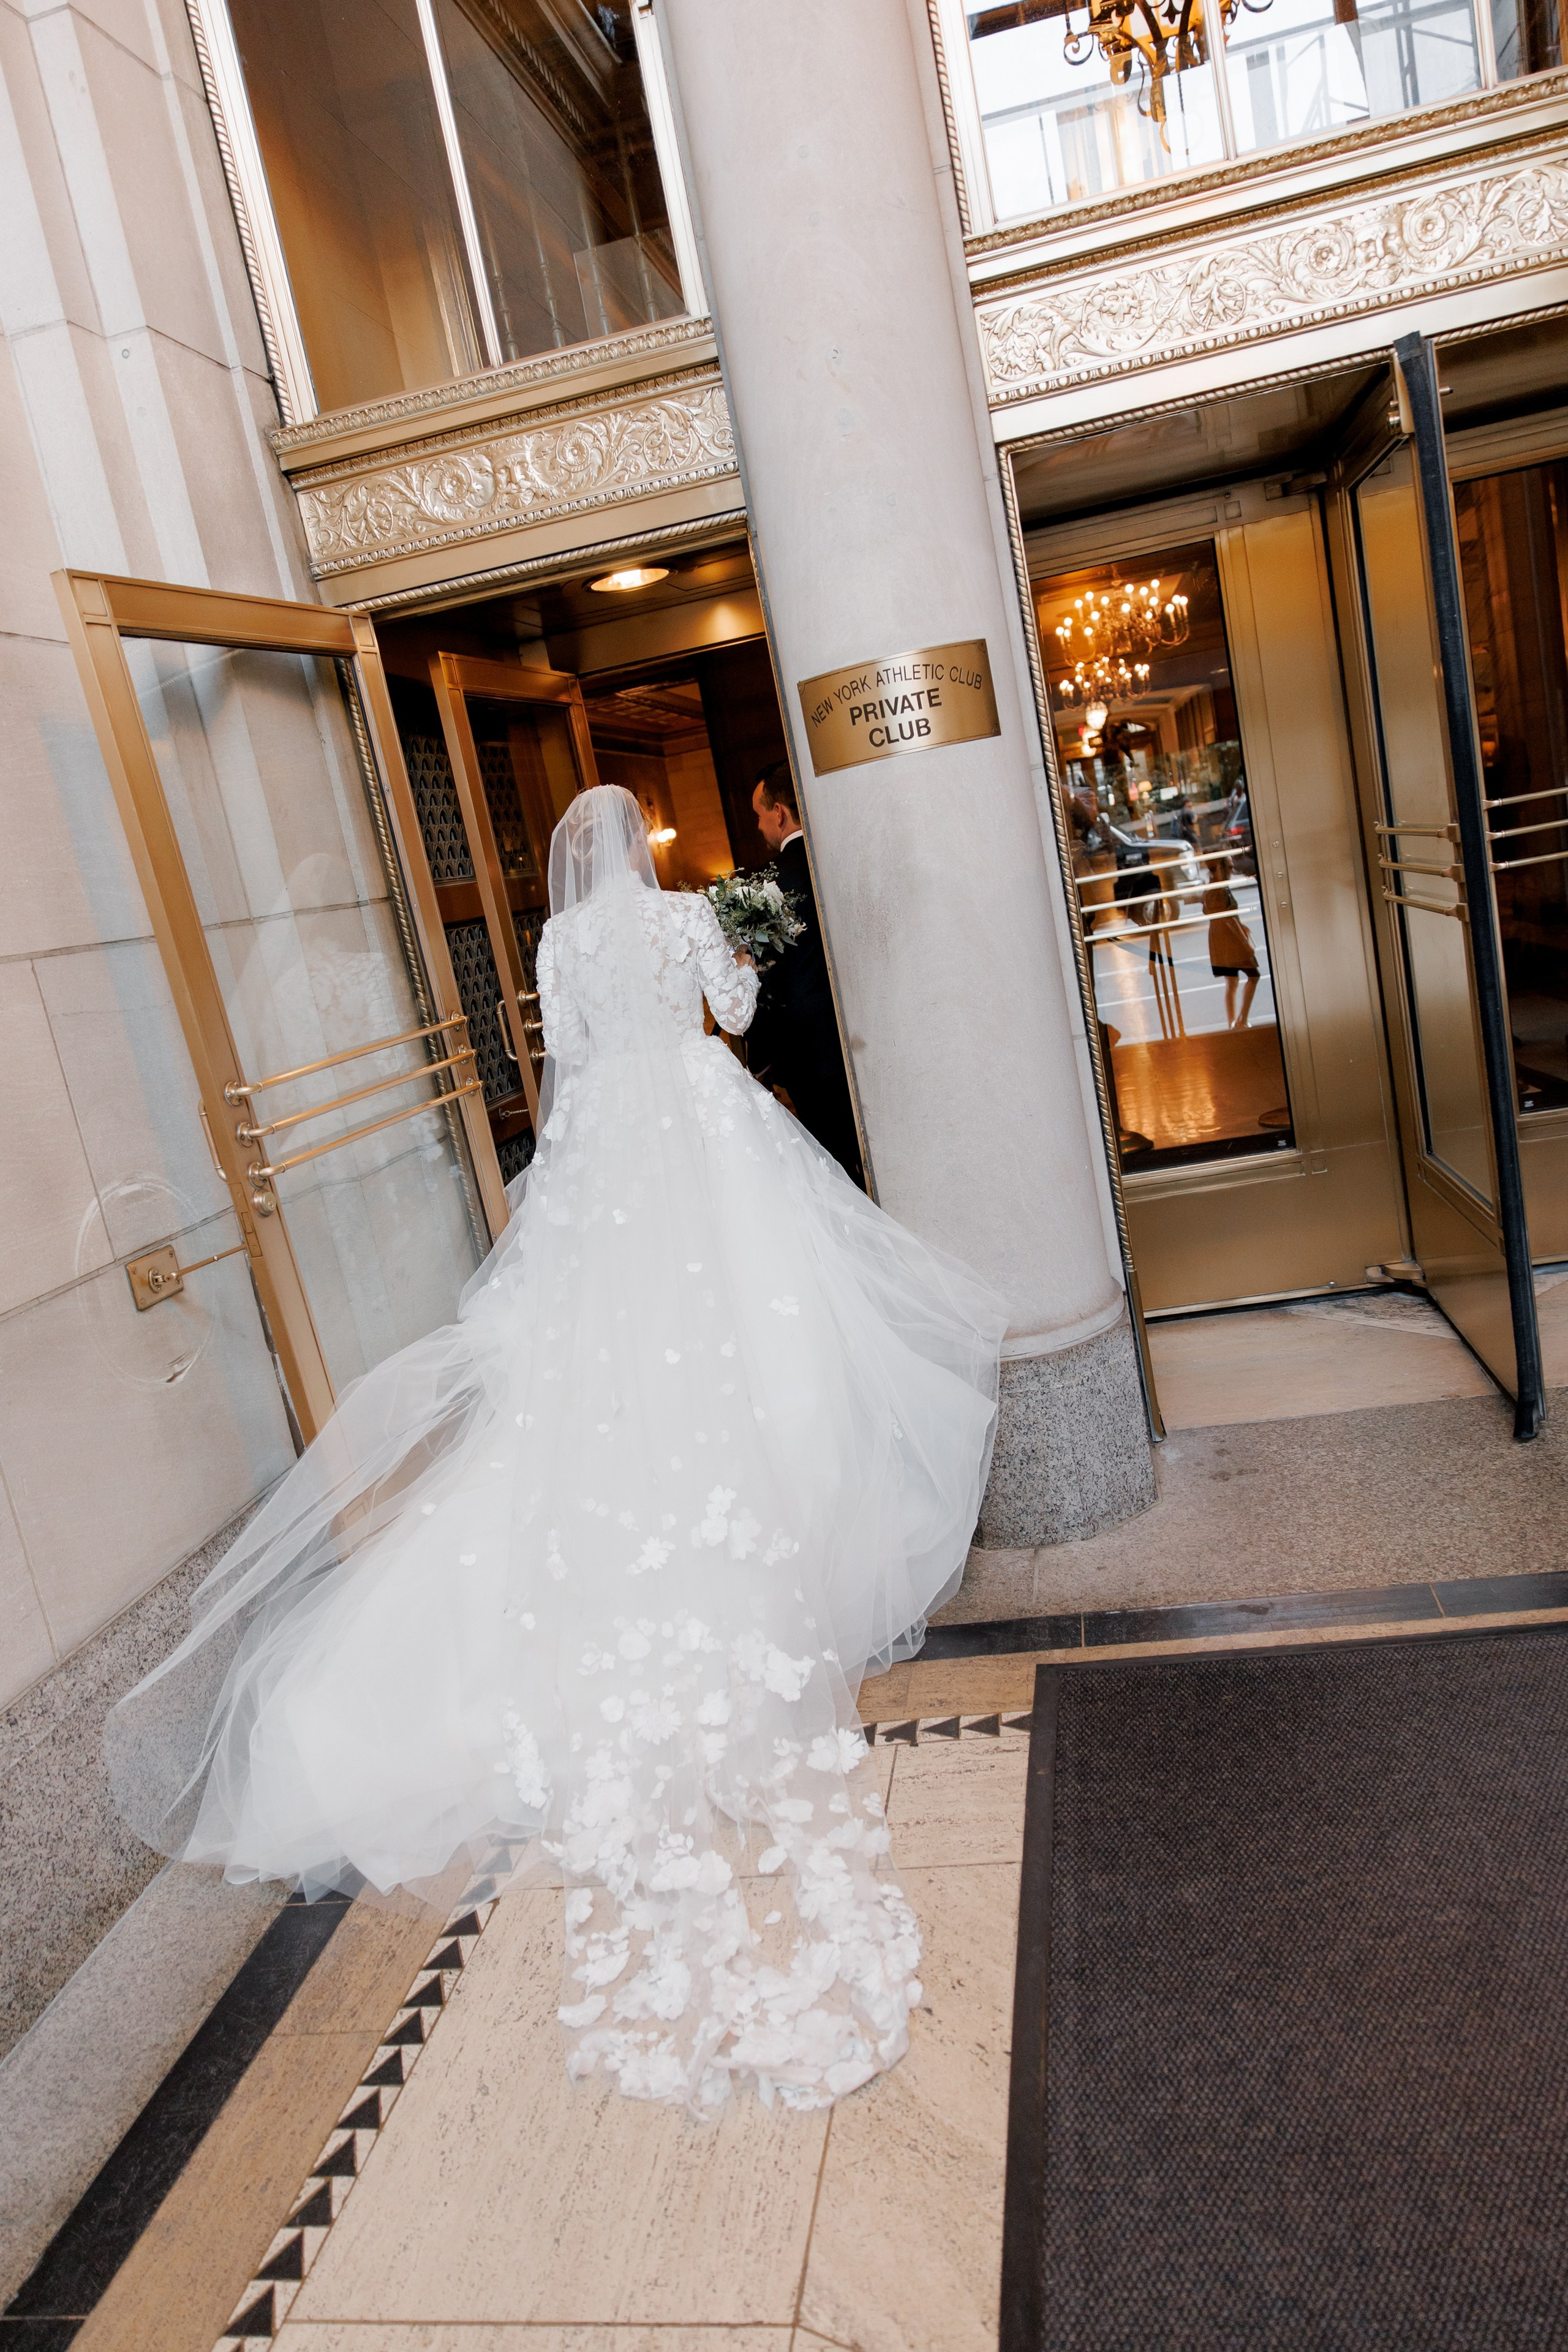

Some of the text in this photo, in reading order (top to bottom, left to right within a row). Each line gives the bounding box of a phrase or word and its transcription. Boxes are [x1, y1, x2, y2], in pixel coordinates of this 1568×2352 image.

[810, 664, 982, 728] NEW YORK ATHLETIC CLUB
[849, 687, 942, 726] PRIVATE
[869, 718, 931, 747] CLUB
